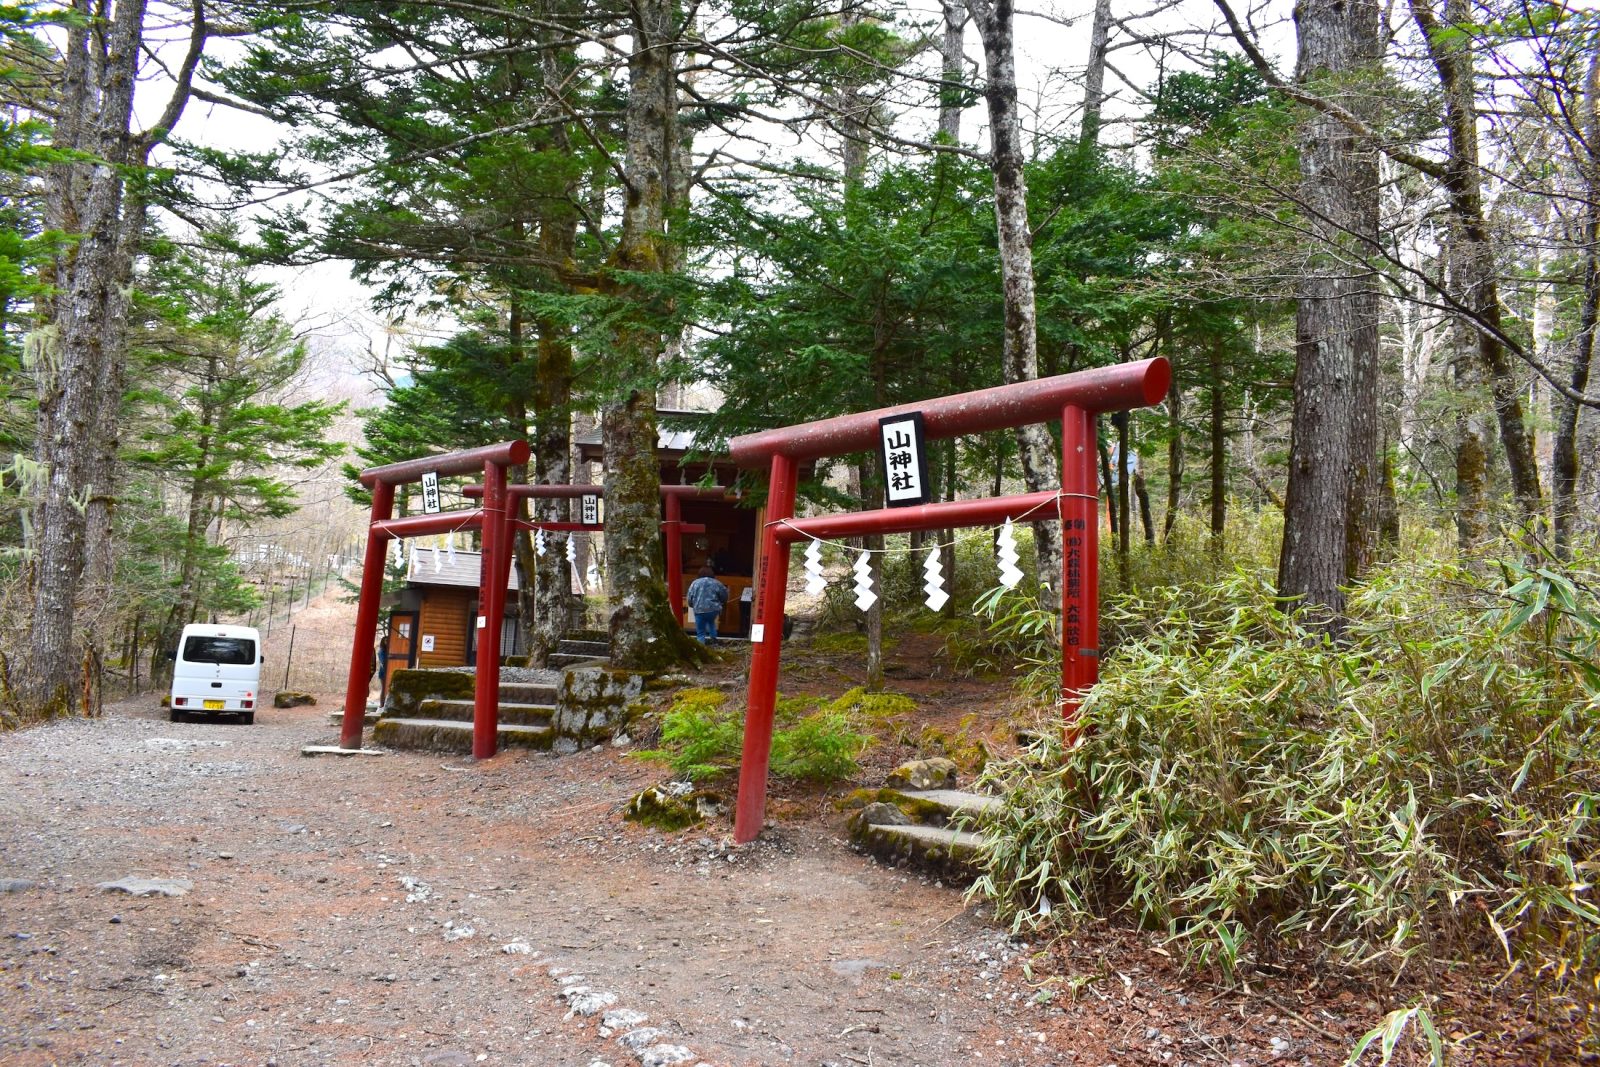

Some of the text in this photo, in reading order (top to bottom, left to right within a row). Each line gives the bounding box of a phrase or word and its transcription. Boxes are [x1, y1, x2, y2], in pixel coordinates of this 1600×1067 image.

[887, 430, 915, 491] 山神社
[425, 477, 438, 509] 山神社
[584, 497, 595, 520] 山神社
